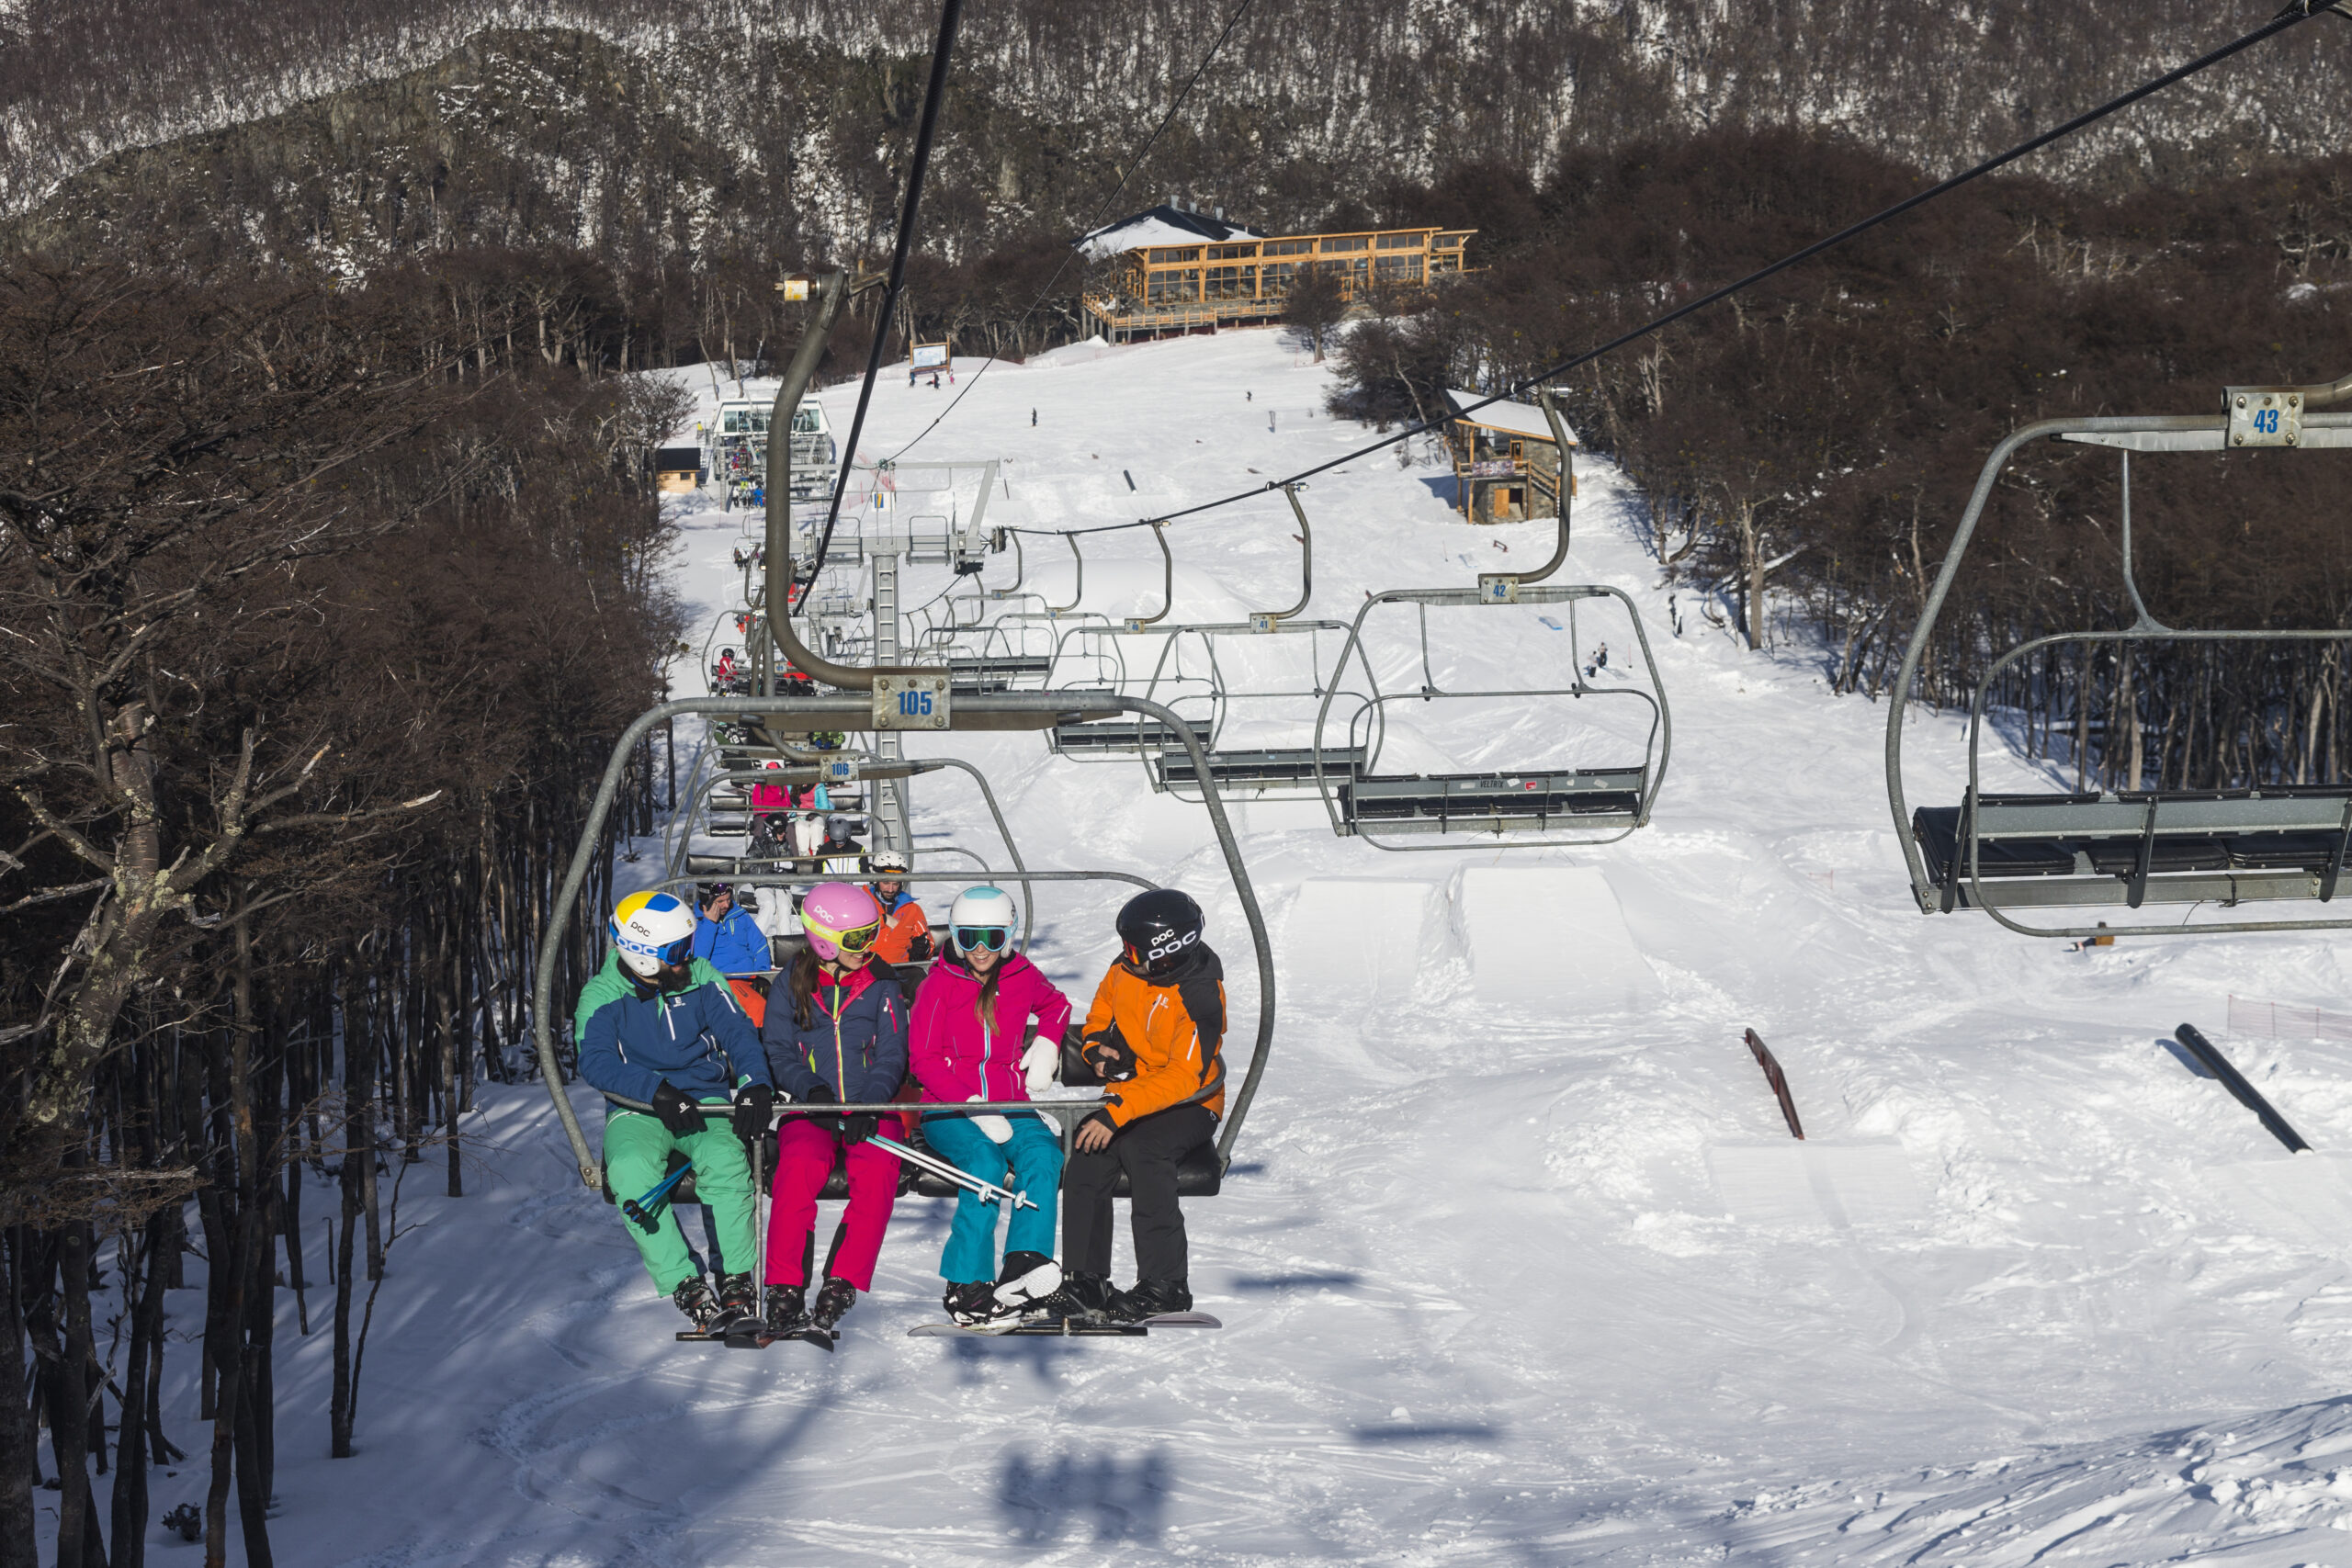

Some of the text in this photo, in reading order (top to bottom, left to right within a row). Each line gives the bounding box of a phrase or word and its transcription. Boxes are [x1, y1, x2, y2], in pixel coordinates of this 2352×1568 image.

[2253, 409, 2278, 434] 43
[1493, 584, 1506, 597] 42
[897, 691, 933, 716] 105
[831, 763, 849, 775] 106
